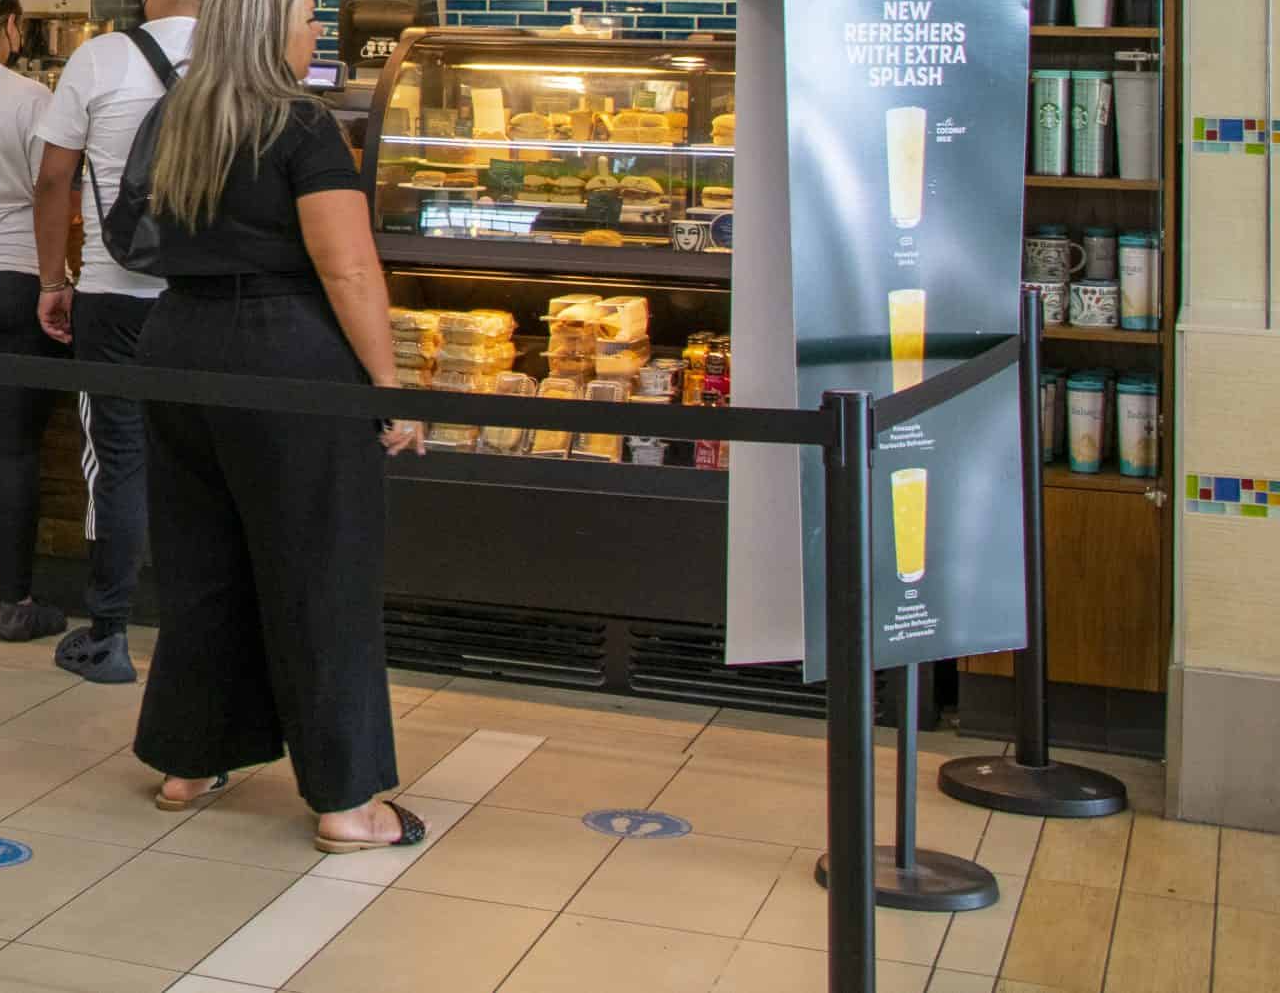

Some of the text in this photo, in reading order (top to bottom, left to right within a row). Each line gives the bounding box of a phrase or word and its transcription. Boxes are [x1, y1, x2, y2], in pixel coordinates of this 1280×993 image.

[883, 0, 933, 21] NEW
[844, 22, 967, 43] REFRESHERS
[847, 44, 967, 64] WITH EXTRA
[869, 66, 944, 87] SPLASH
[936, 127, 967, 135] COCONUT
